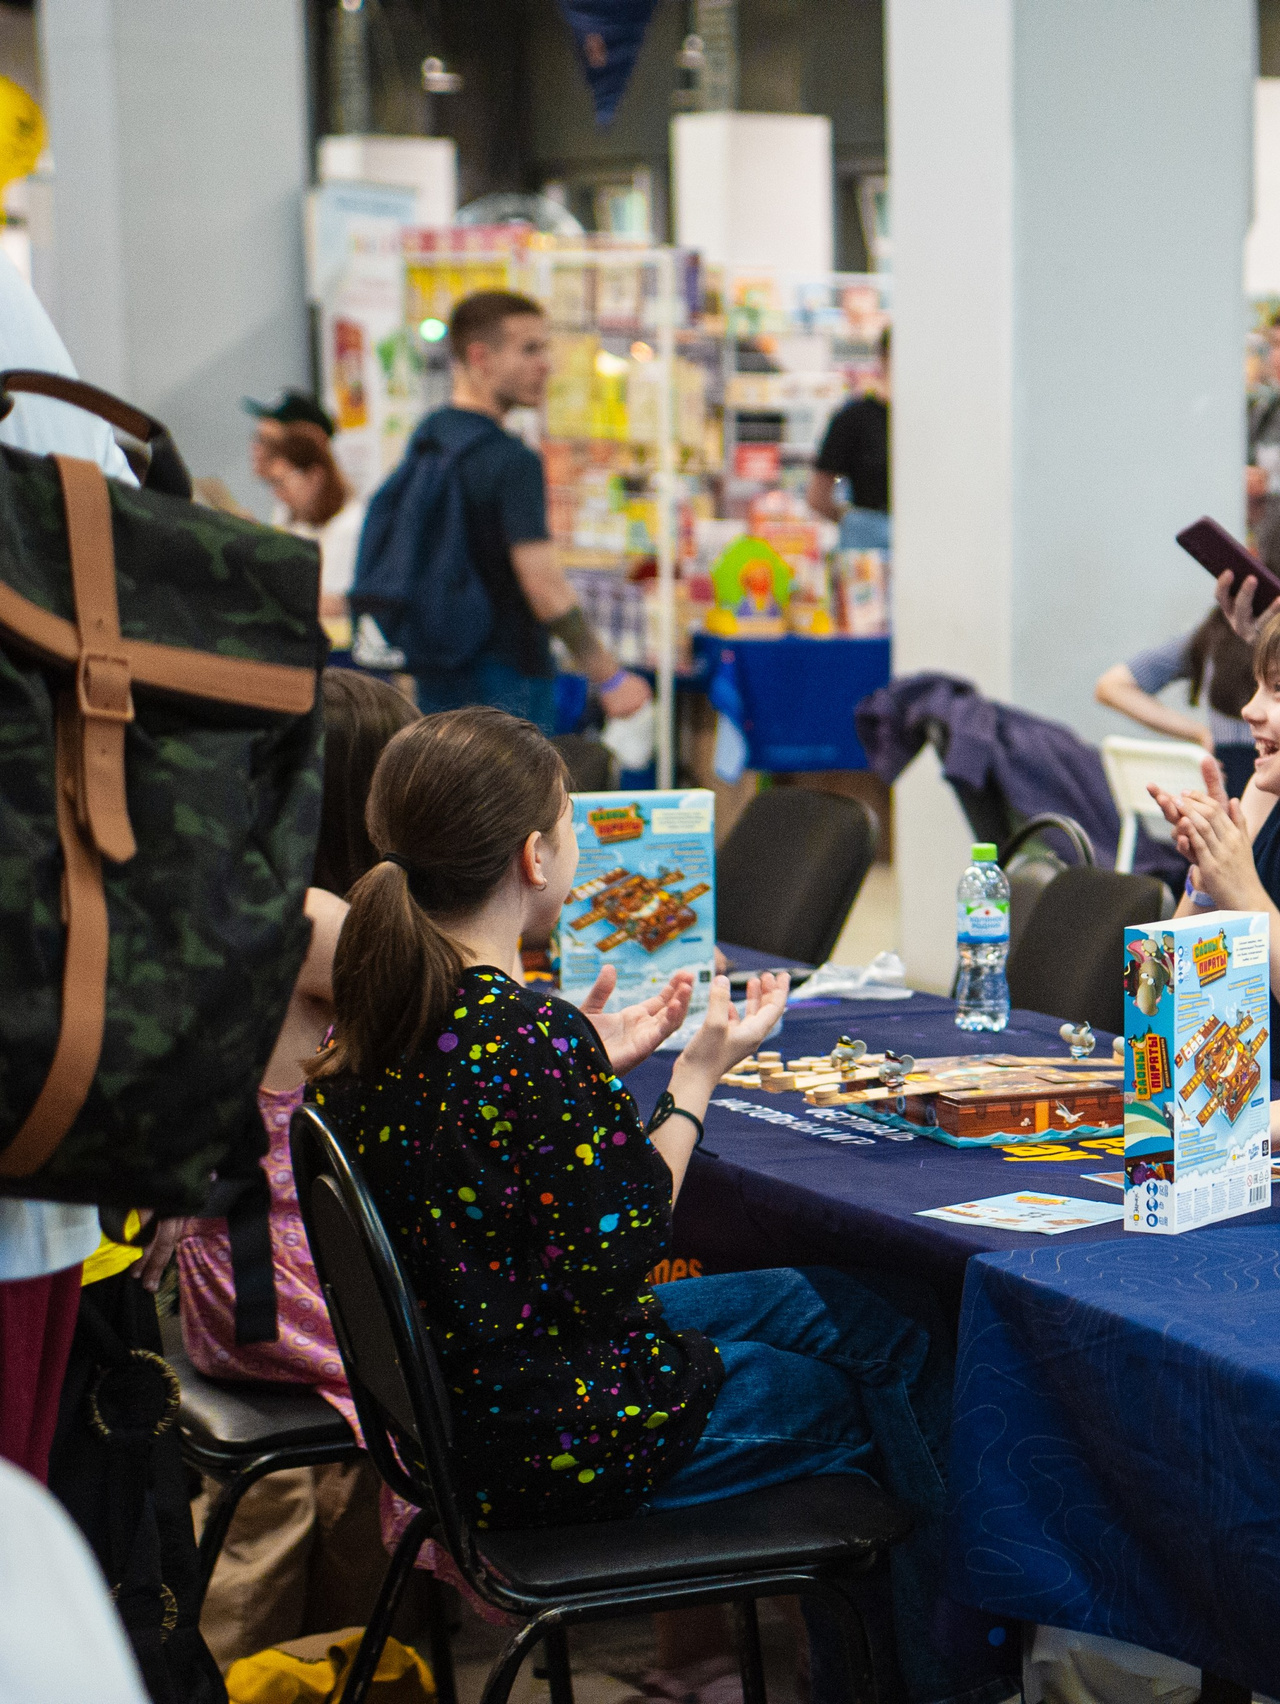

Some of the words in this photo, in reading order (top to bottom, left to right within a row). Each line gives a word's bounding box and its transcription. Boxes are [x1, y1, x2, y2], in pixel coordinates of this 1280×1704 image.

[1194, 940, 1218, 958] СЛОНЫ
[1199, 954, 1227, 974] ПИРАТЫ
[1148, 1036, 1161, 1088] ПИРАТЫ
[1135, 1051, 1147, 1095] СЛОНЫ
[820, 1132, 876, 1145] ИГР
